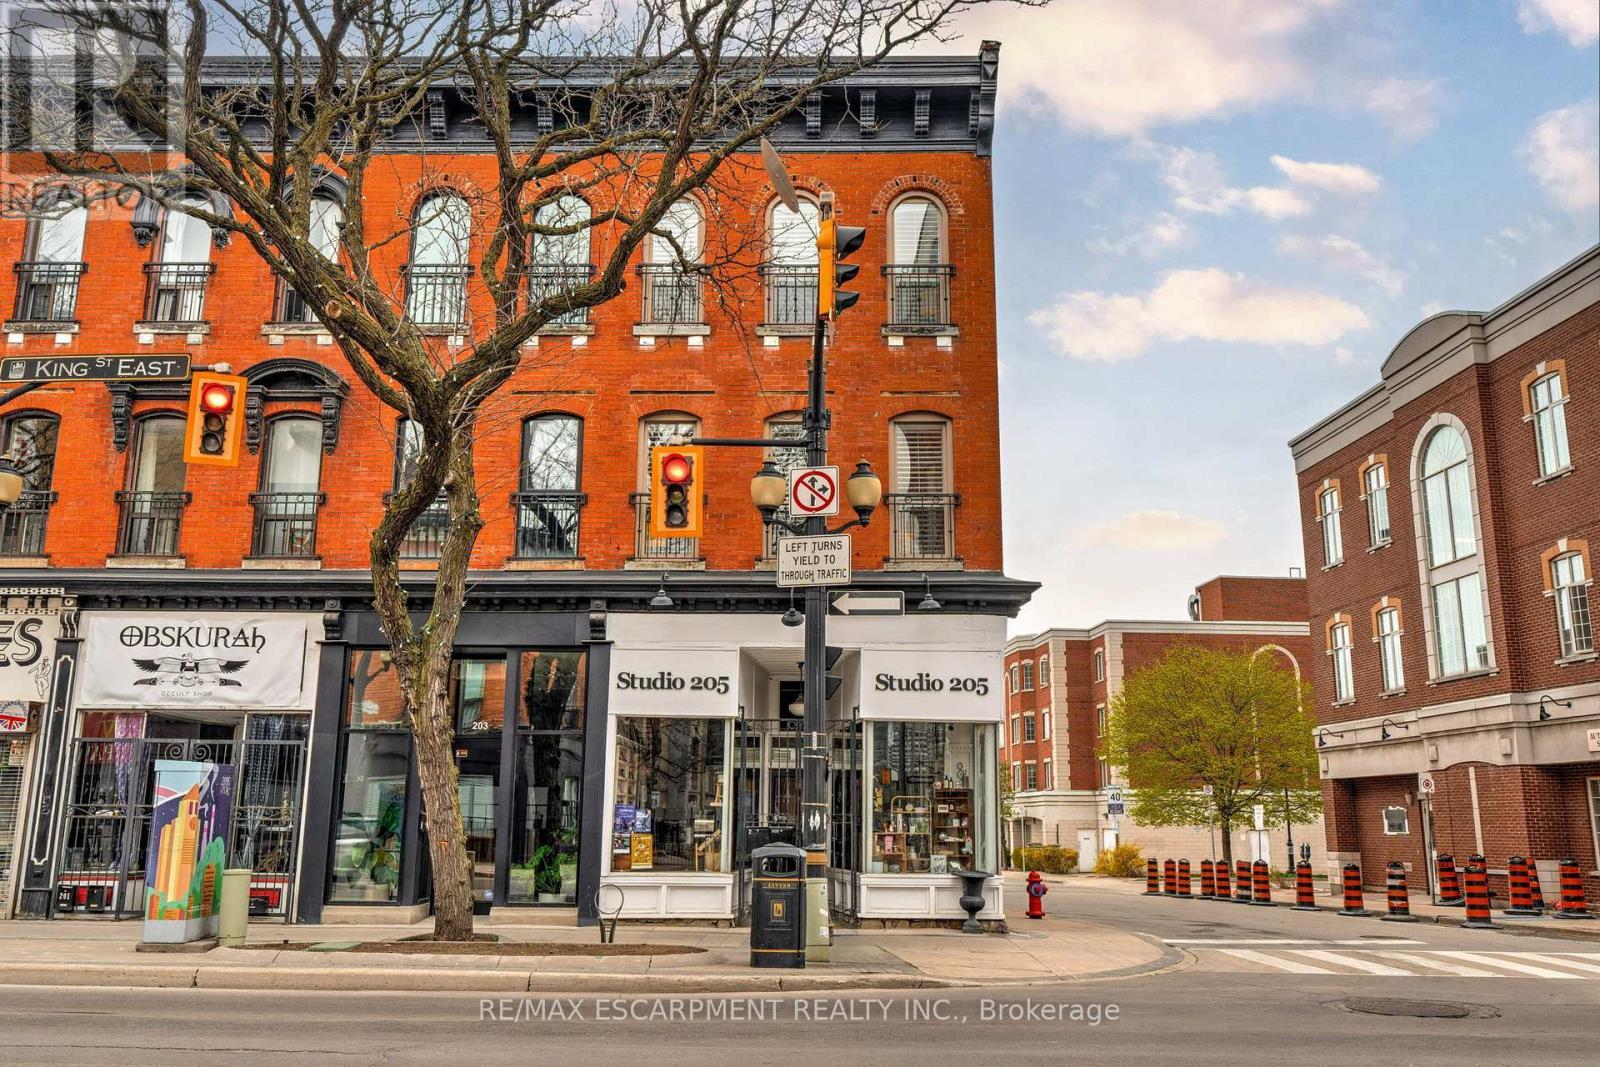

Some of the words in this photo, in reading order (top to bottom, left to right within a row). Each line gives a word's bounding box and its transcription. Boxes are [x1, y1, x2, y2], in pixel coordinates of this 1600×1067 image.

[35, 360, 88, 377] KING
[117, 359, 176, 376] EAST
[785, 542, 808, 553] LEFT
[812, 540, 843, 552] TURNS
[793, 555, 820, 566] YIELD
[824, 554, 836, 565] TO
[781, 570, 814, 581] THROUGH
[817, 568, 847, 579] TRAFFIC
[616, 671, 686, 690] Studio
[689, 676, 730, 695] 205
[875, 673, 944, 692] Studio
[949, 677, 989, 696] 205
[472, 721, 489, 730] 203
[1110, 792, 1121, 801] 40
[59, 892, 70, 900] 201
